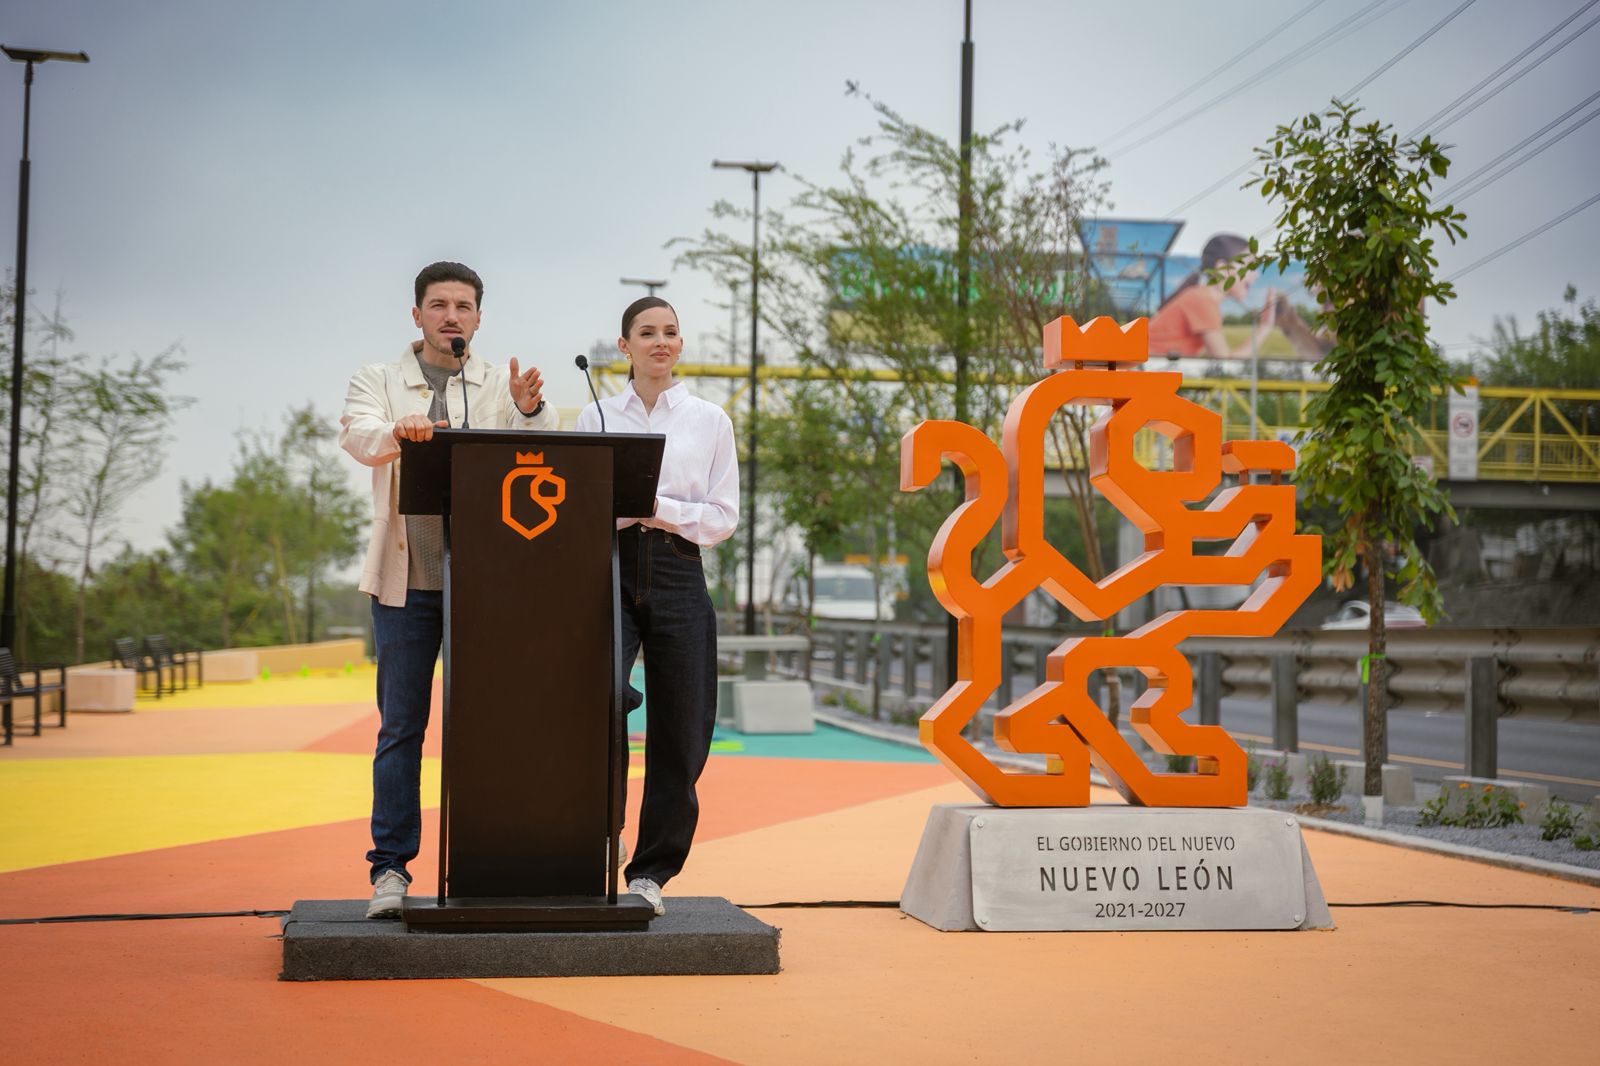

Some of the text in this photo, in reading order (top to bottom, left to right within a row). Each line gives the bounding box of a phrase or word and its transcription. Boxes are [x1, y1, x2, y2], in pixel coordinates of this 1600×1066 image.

[1037, 836, 1235, 852] EL GOBIERNO DEL NUEVO
[1039, 858, 1234, 892] NUEVO LEÓN
[1095, 902, 1186, 918] 2021-2027
